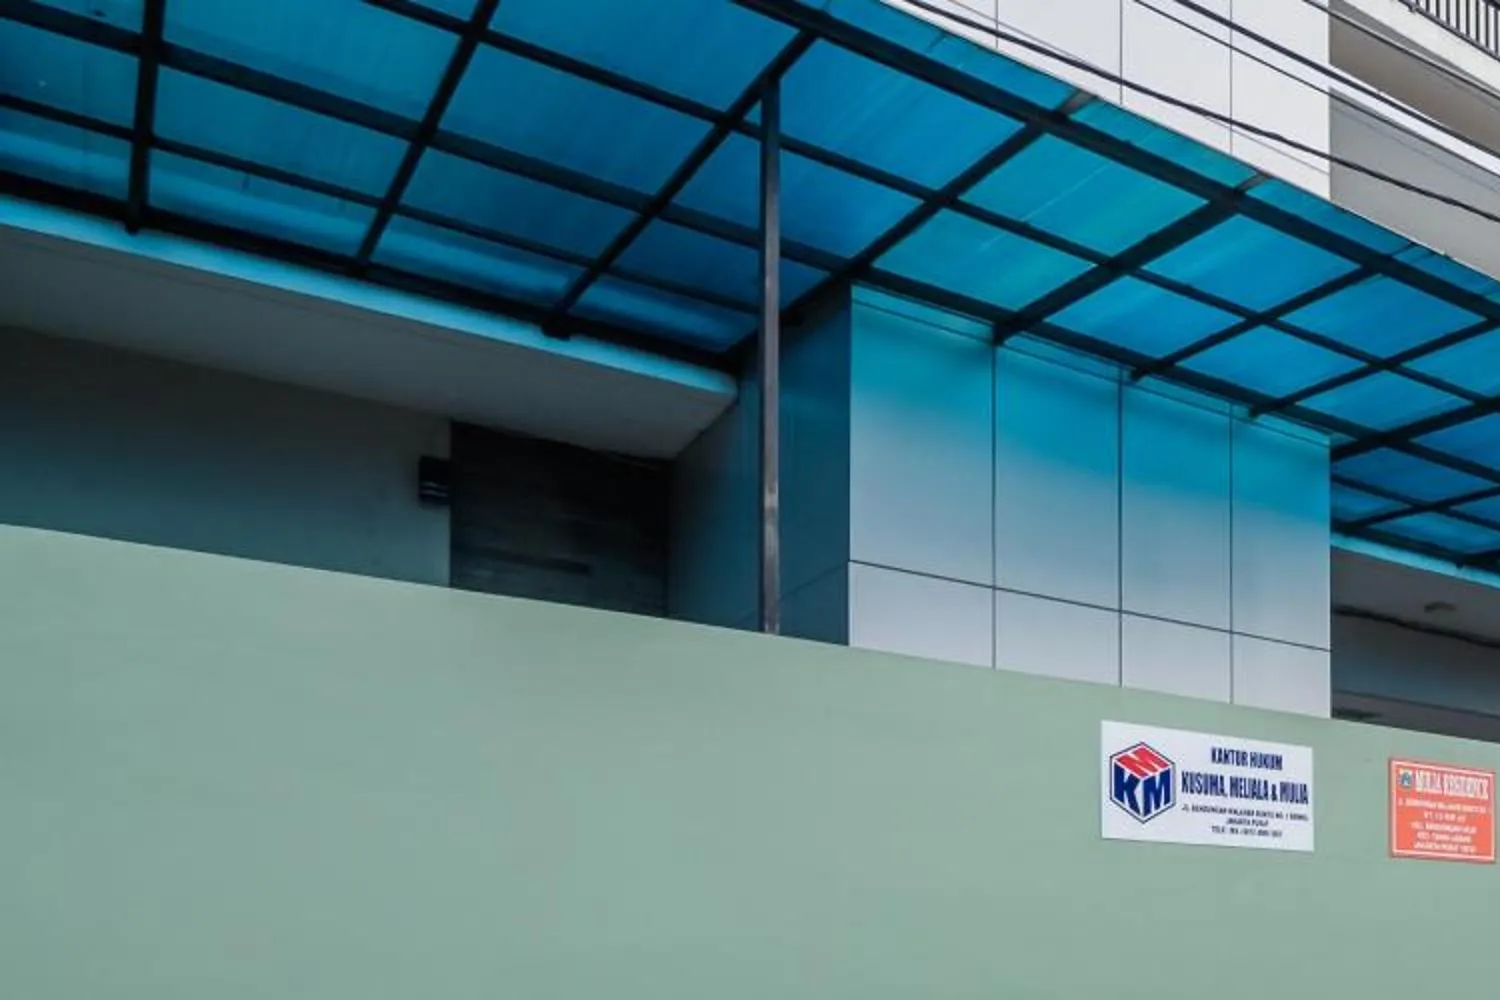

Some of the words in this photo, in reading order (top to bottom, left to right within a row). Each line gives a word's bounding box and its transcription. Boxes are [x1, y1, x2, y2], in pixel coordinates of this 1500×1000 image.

[1211, 747, 1248, 767] KANTOR
[1250, 752, 1283, 771] HUKUM
[1271, 783, 1278, 801] &
